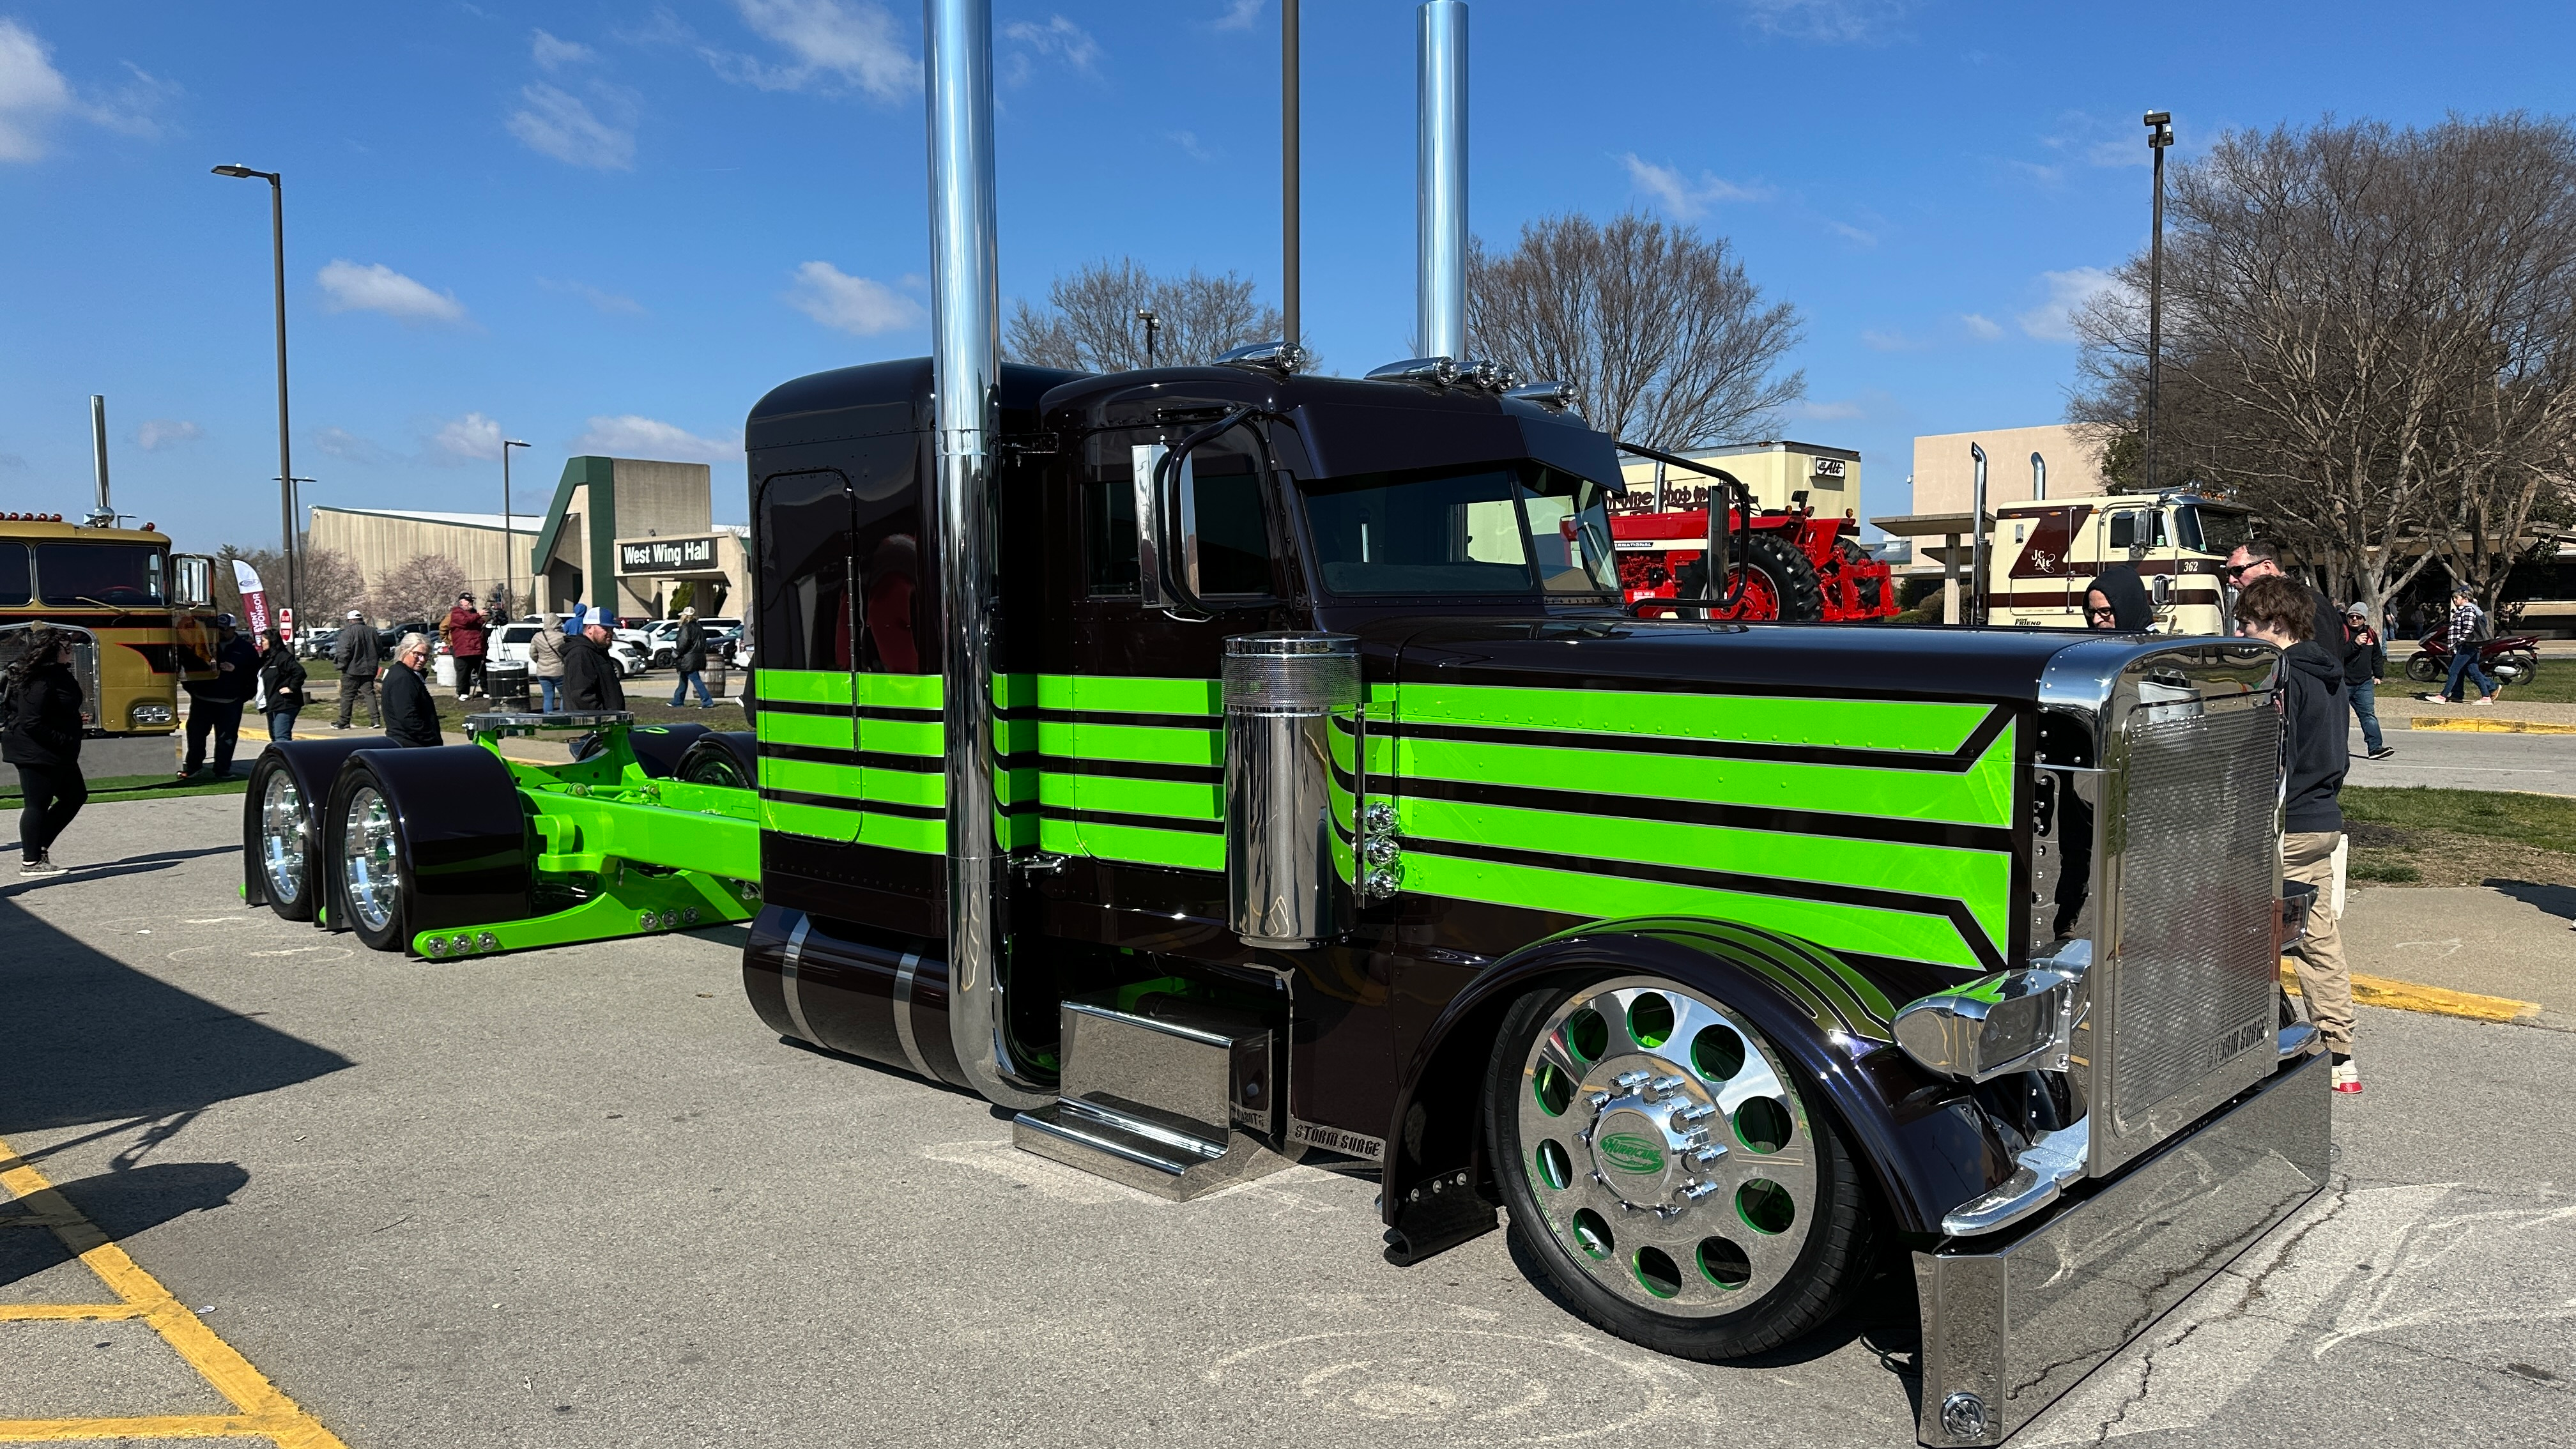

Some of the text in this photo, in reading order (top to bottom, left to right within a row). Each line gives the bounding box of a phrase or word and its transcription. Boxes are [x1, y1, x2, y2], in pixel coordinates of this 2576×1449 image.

[1818, 461, 1843, 475] Alt
[624, 540, 709, 567] West Wing Hall
[2183, 561, 2198, 572] 362
[250, 611, 261, 632] EVENT
[252, 593, 268, 632] SPONSOR
[2240, 1016, 2267, 1051] SURGE
[1763, 1046, 1813, 1142] FORGED
[1294, 1124, 1381, 1156] STORM SURGE
